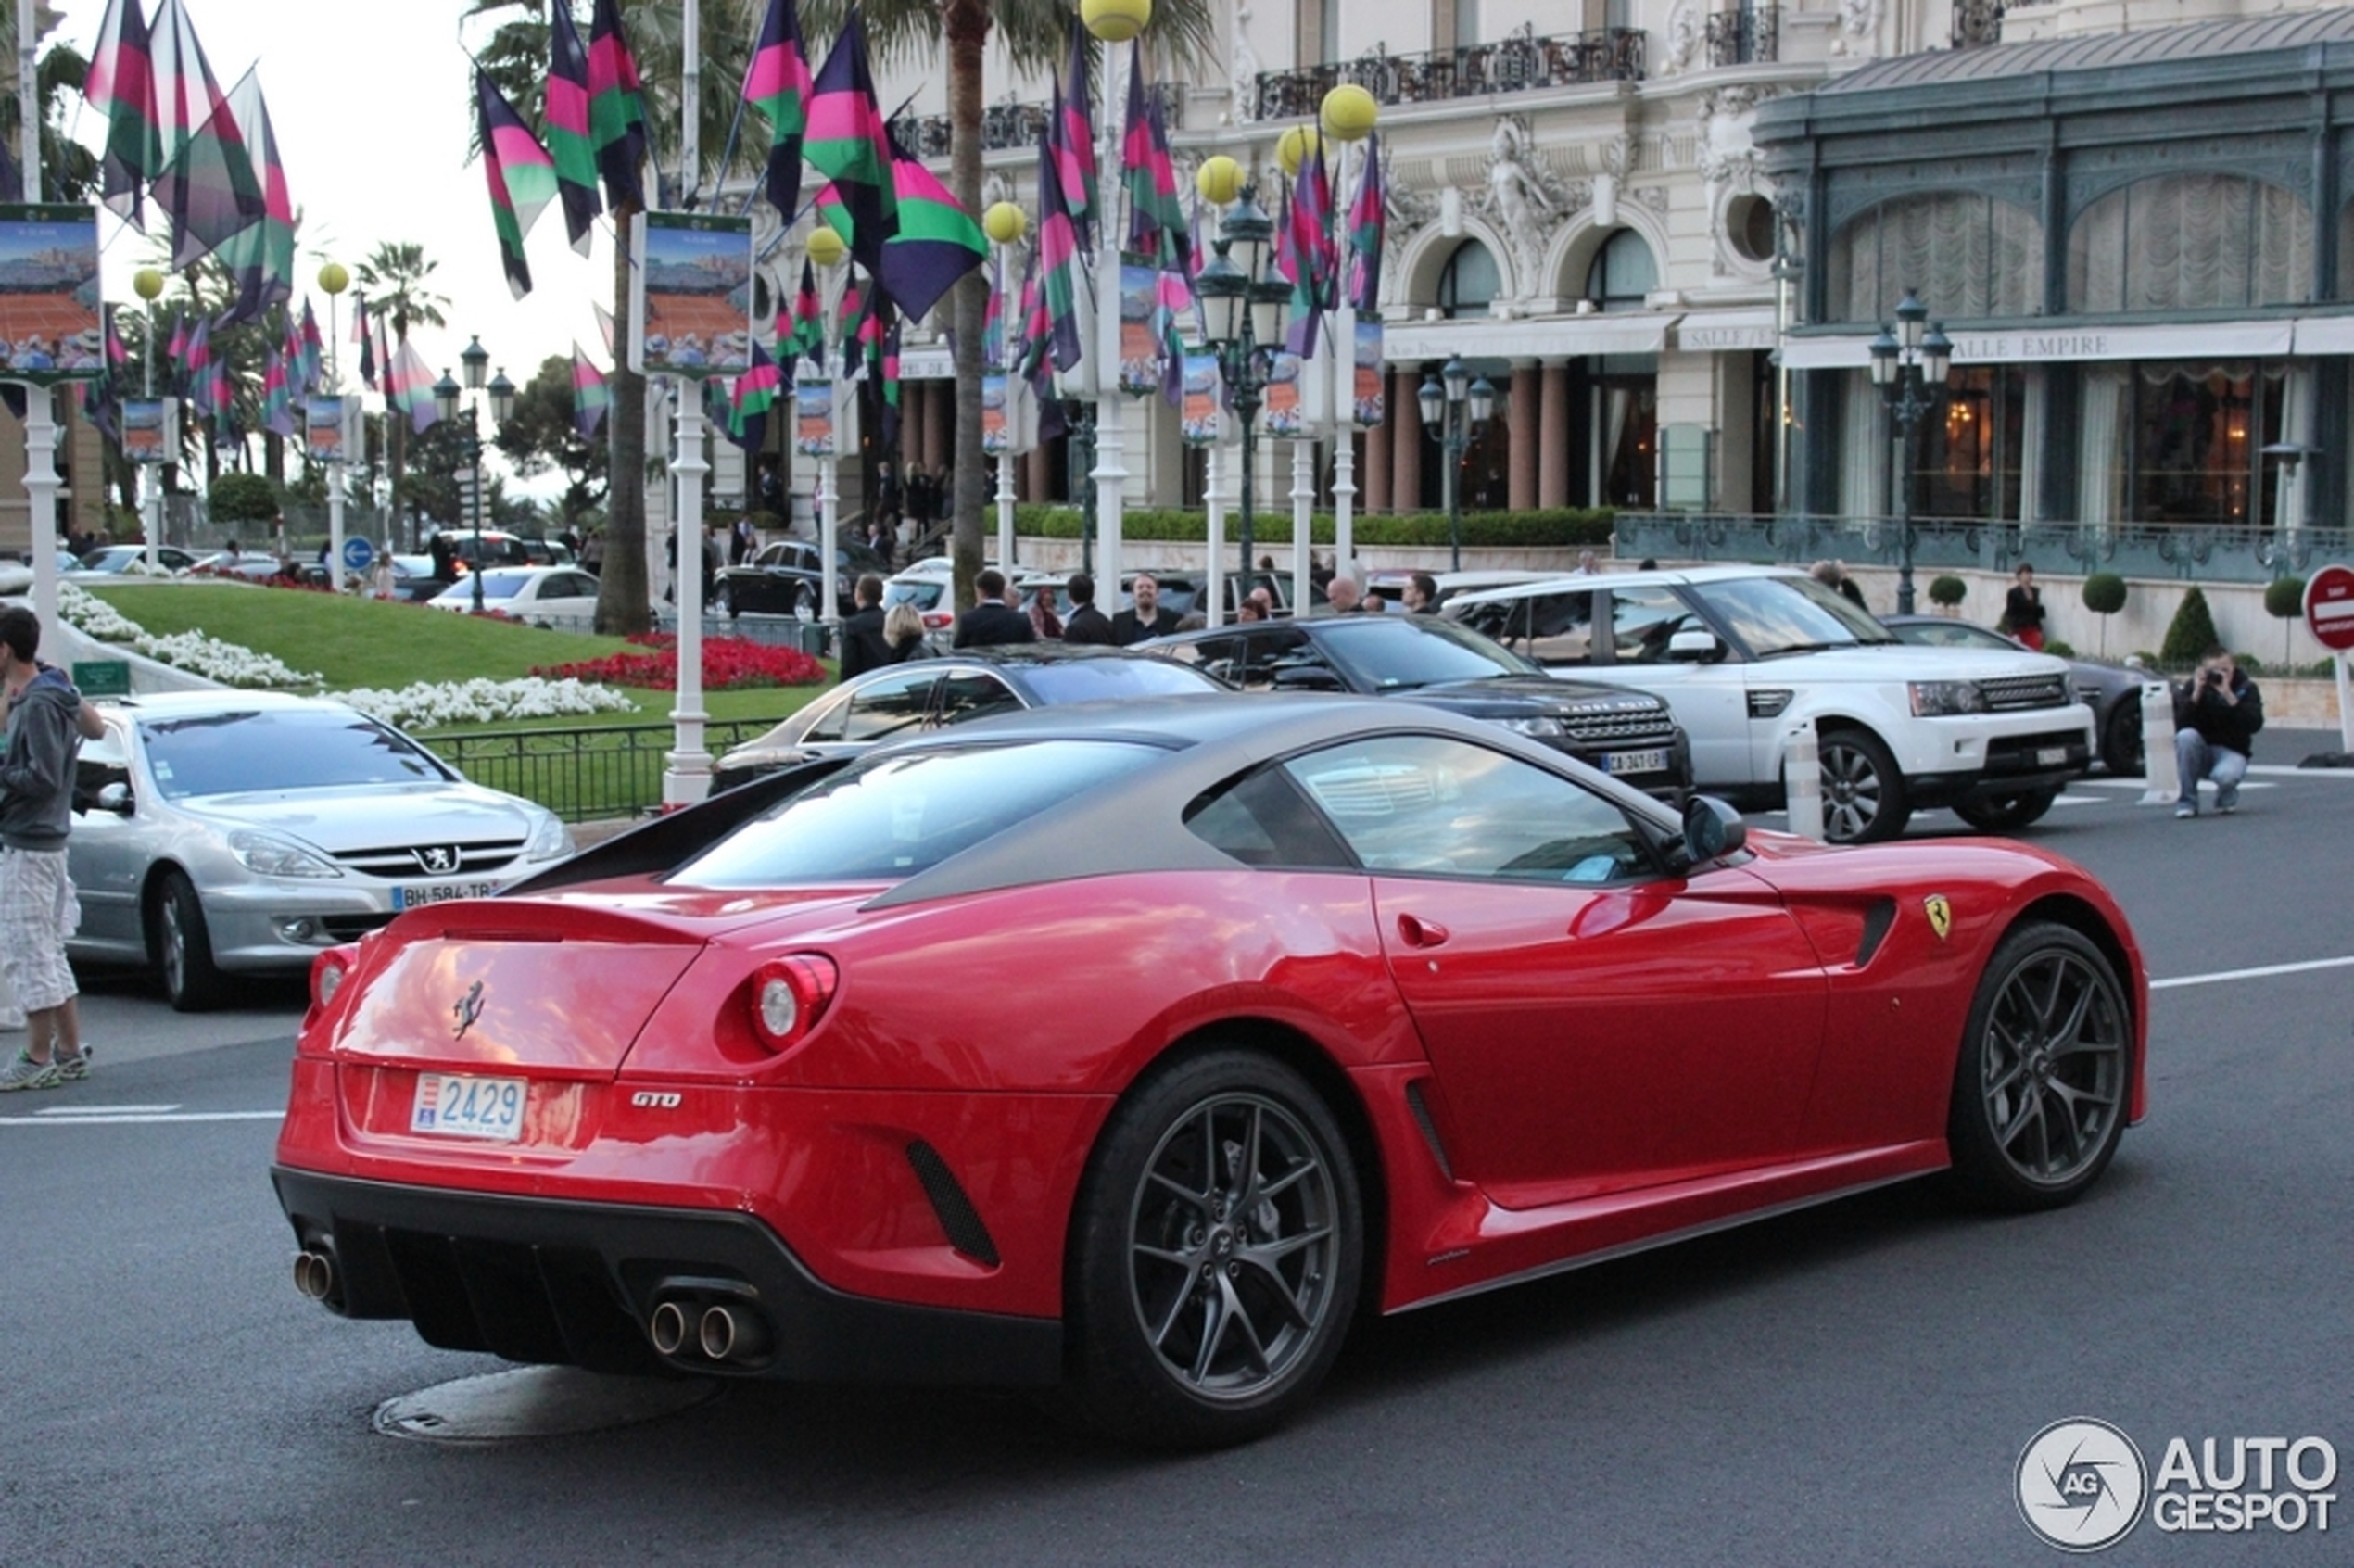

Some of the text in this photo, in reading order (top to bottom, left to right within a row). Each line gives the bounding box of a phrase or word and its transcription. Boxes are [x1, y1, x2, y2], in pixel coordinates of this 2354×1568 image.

[1691, 330, 1744, 347] SALLE
[1954, 335, 2108, 359] ALLE EMPIRE
[442, 1080, 518, 1125] 2429
[632, 1091, 681, 1107] GTO
